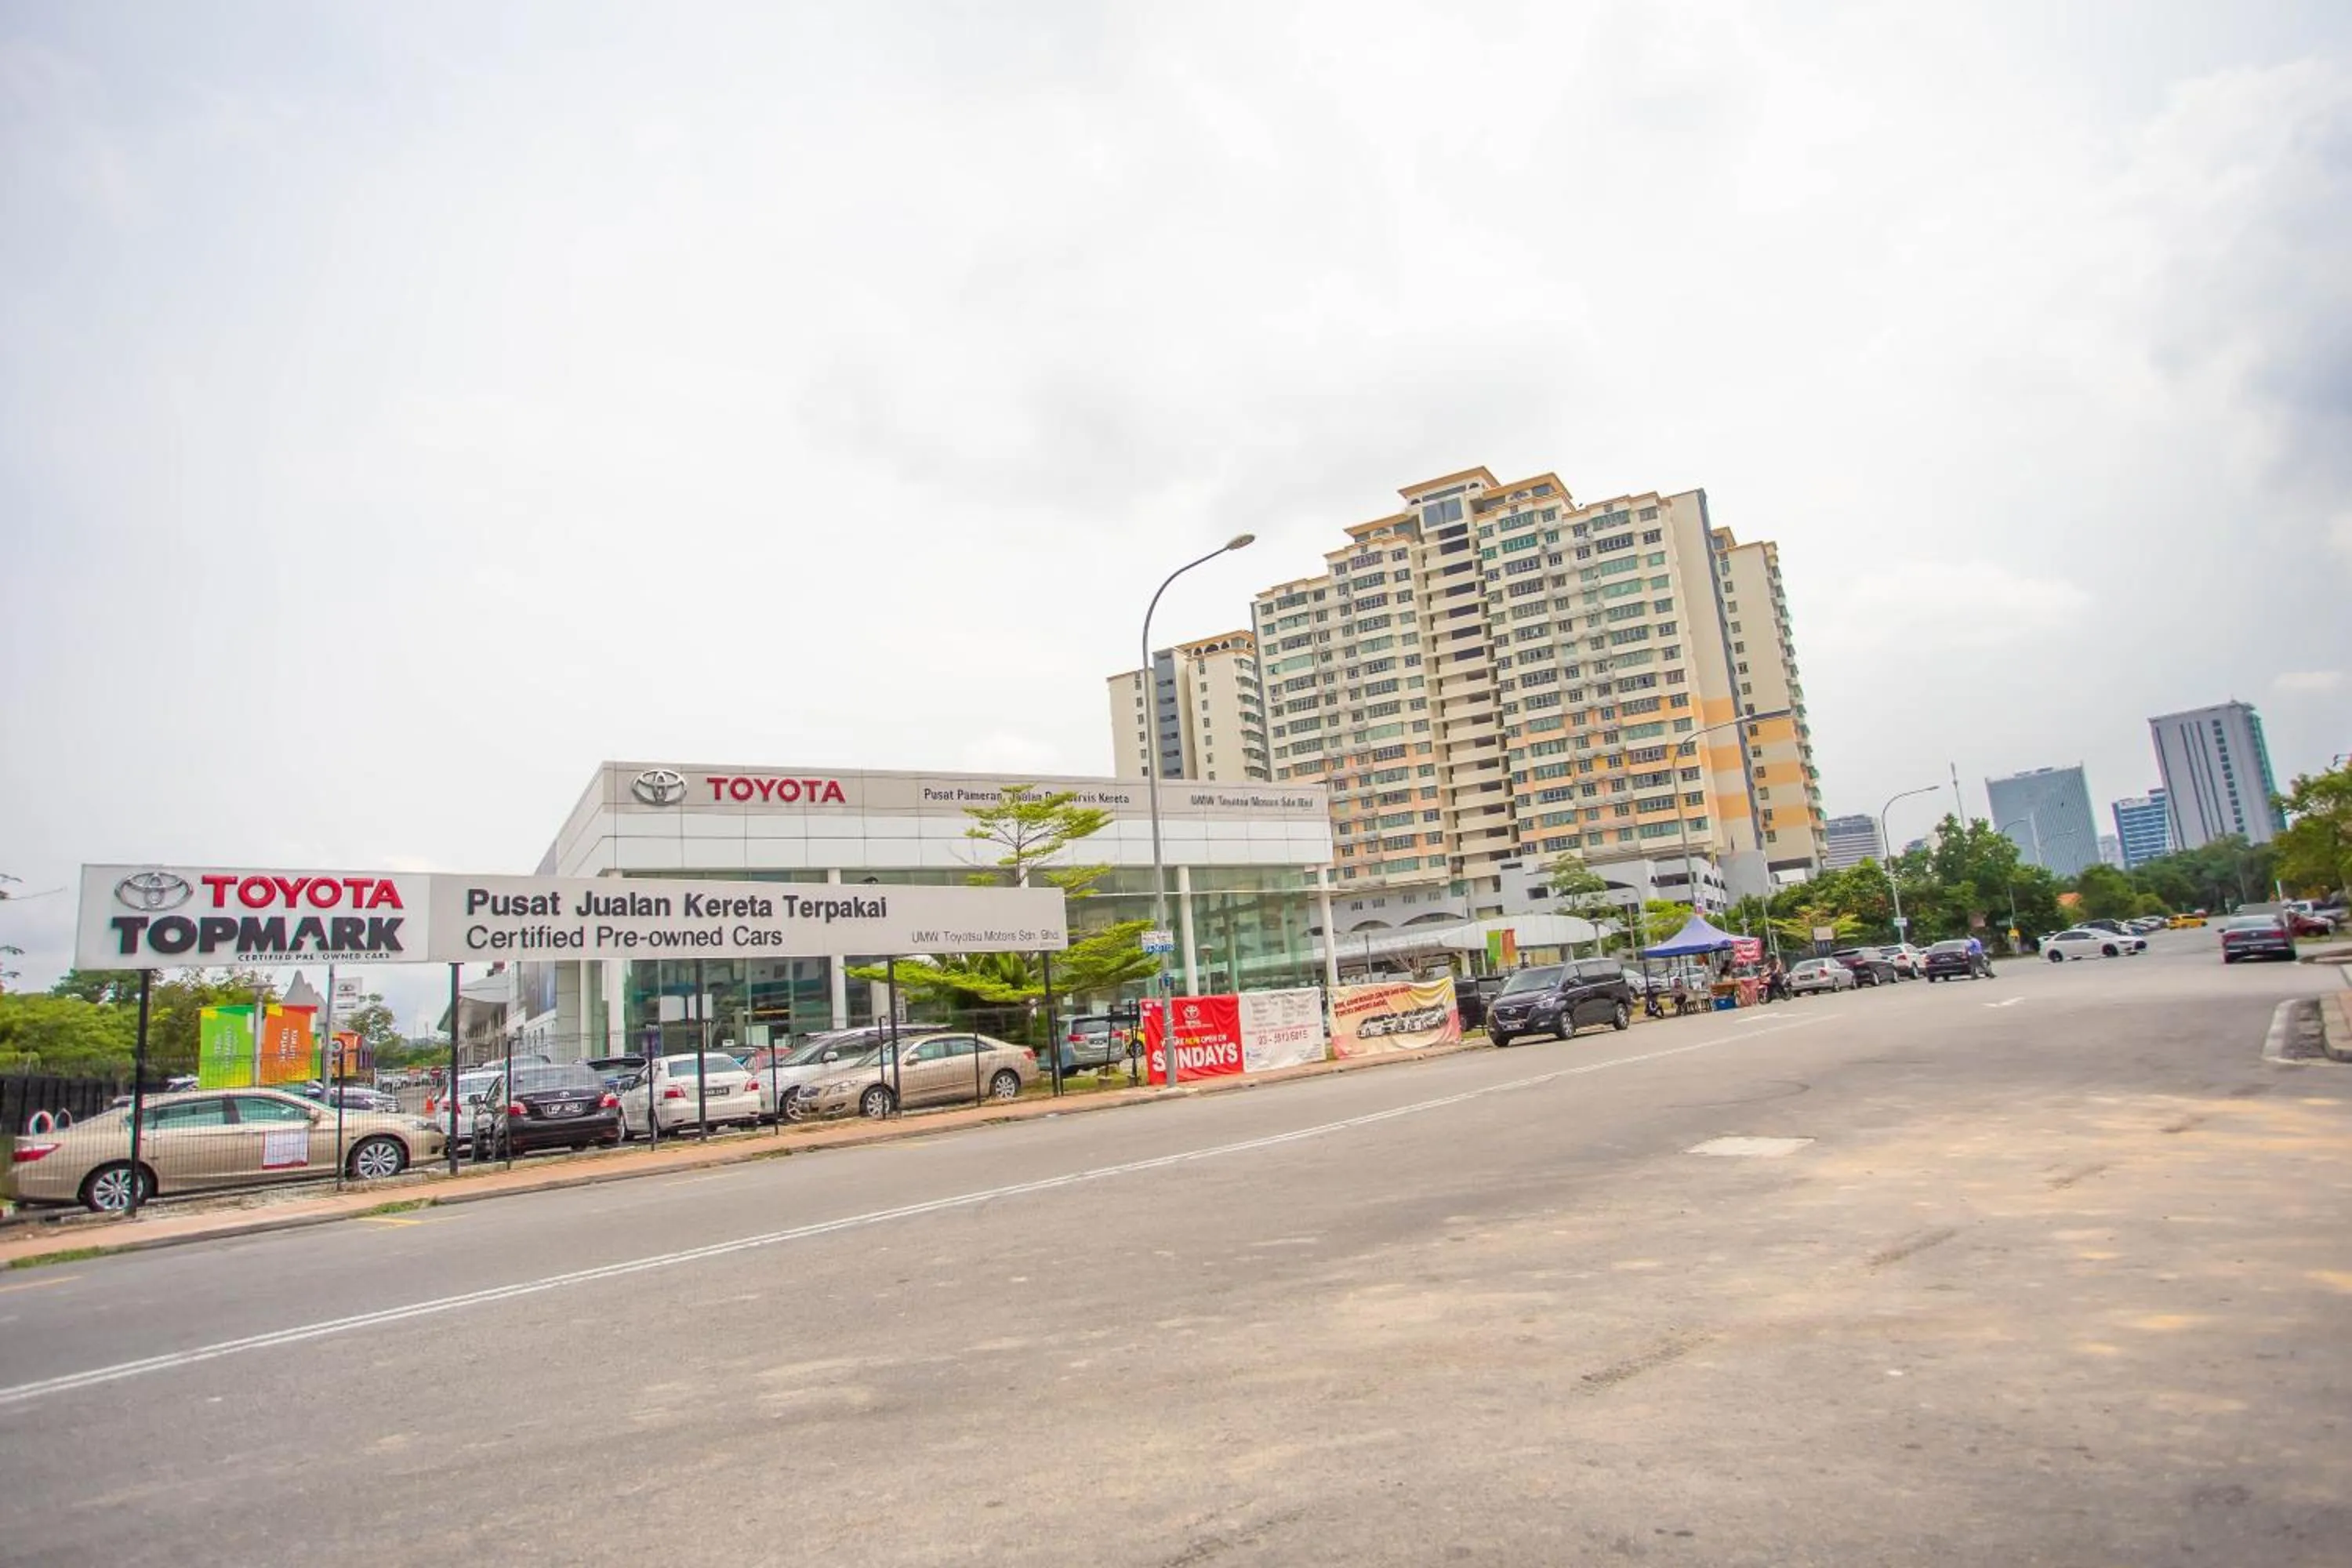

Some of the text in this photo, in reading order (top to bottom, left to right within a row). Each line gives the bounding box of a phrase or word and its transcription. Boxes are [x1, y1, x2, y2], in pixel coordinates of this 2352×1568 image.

[706, 777, 845, 803] TOYOTA
[924, 788, 954, 800] Pusat
[1099, 793, 1130, 804] Kereta
[201, 875, 405, 909] TOYOTA
[466, 888, 887, 924] Pusat Jualan Kereta Terpakai
[111, 915, 405, 955] TOPMARK
[466, 924, 783, 949] Certified Pre-owned Cars
[912, 931, 938, 943] UMW
[943, 931, 982, 946] Toyotsu
[983, 930, 1016, 942] Motors
[238, 953, 290, 961] CERTIFIED
[322, 952, 361, 960] OWNED
[1152, 1042, 1238, 1072] SNDAYS
